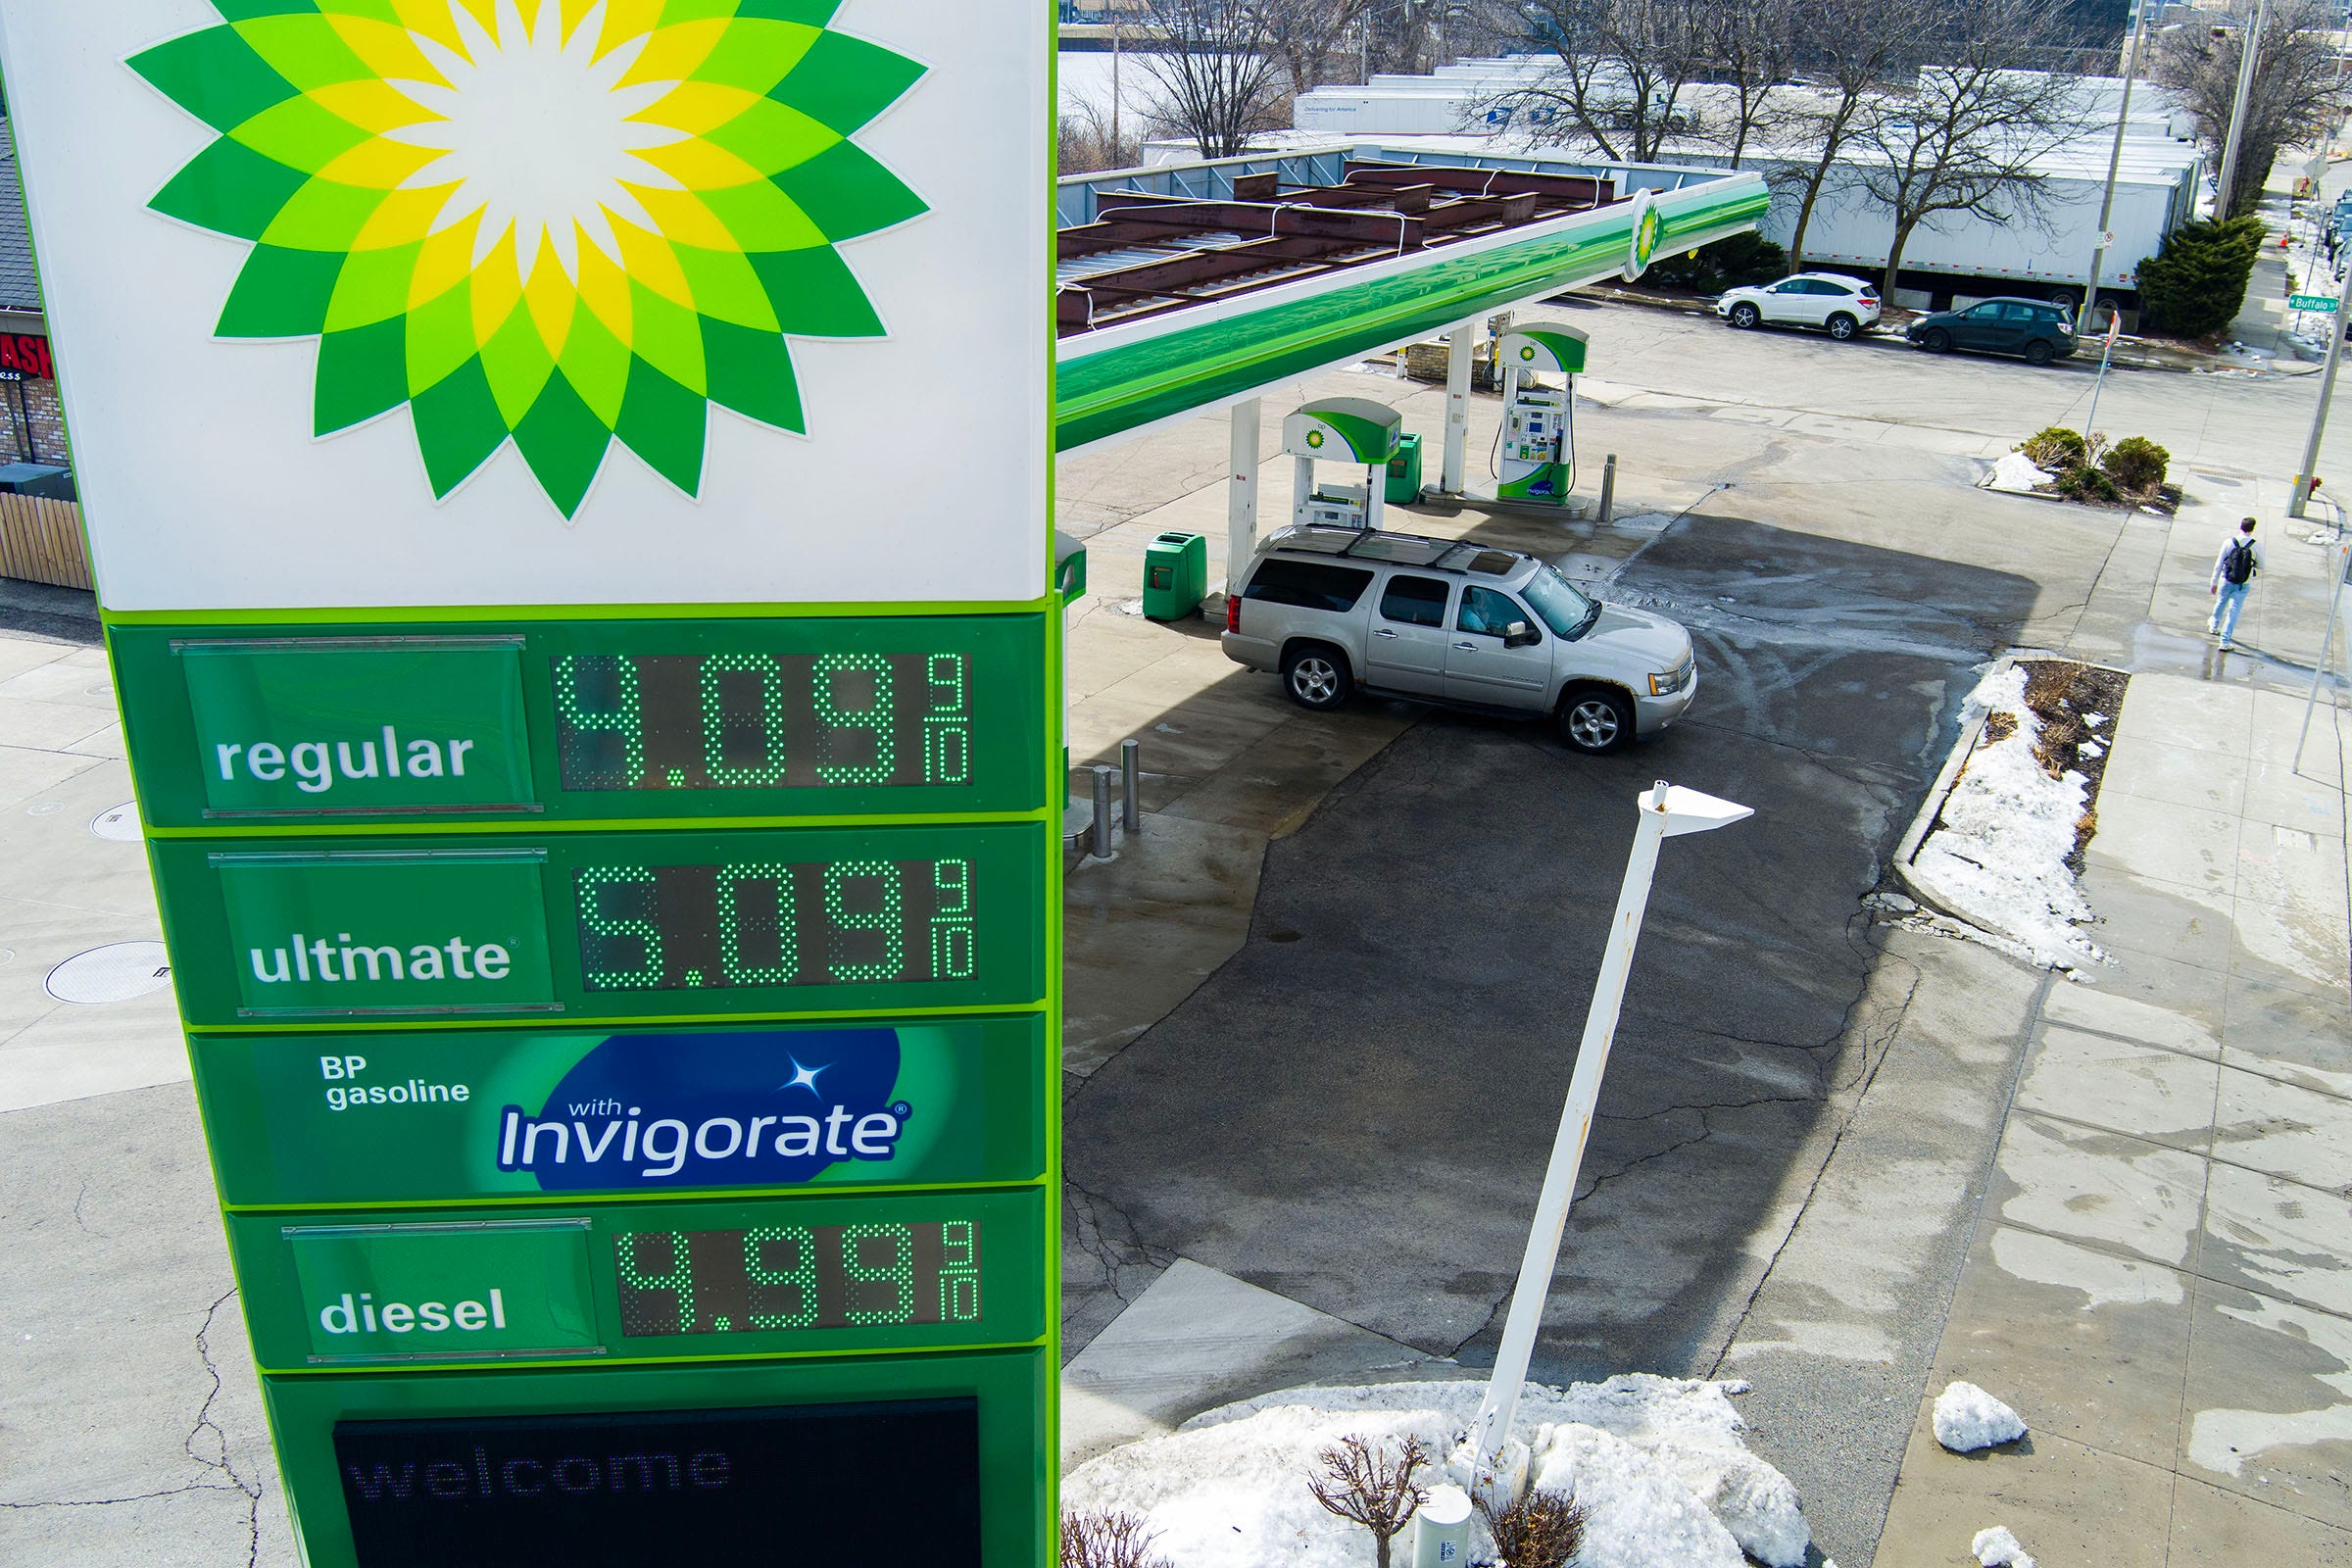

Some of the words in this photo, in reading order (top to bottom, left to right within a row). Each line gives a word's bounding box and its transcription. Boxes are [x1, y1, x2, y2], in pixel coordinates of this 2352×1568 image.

[2296, 298, 2328, 310] Buffalo
[556, 654, 894, 787] 4.09
[218, 726, 473, 793] regular
[578, 860, 904, 988] 5.09
[251, 933, 511, 983] ultimate
[320, 1055, 367, 1079] BP
[325, 1079, 470, 1111] gasoline
[568, 1098, 621, 1117] with
[501, 1103, 898, 1177] Invigorate
[616, 1222, 914, 1333] 4.99
[319, 1289, 506, 1335] diesel
[348, 1445, 730, 1500] welcome
